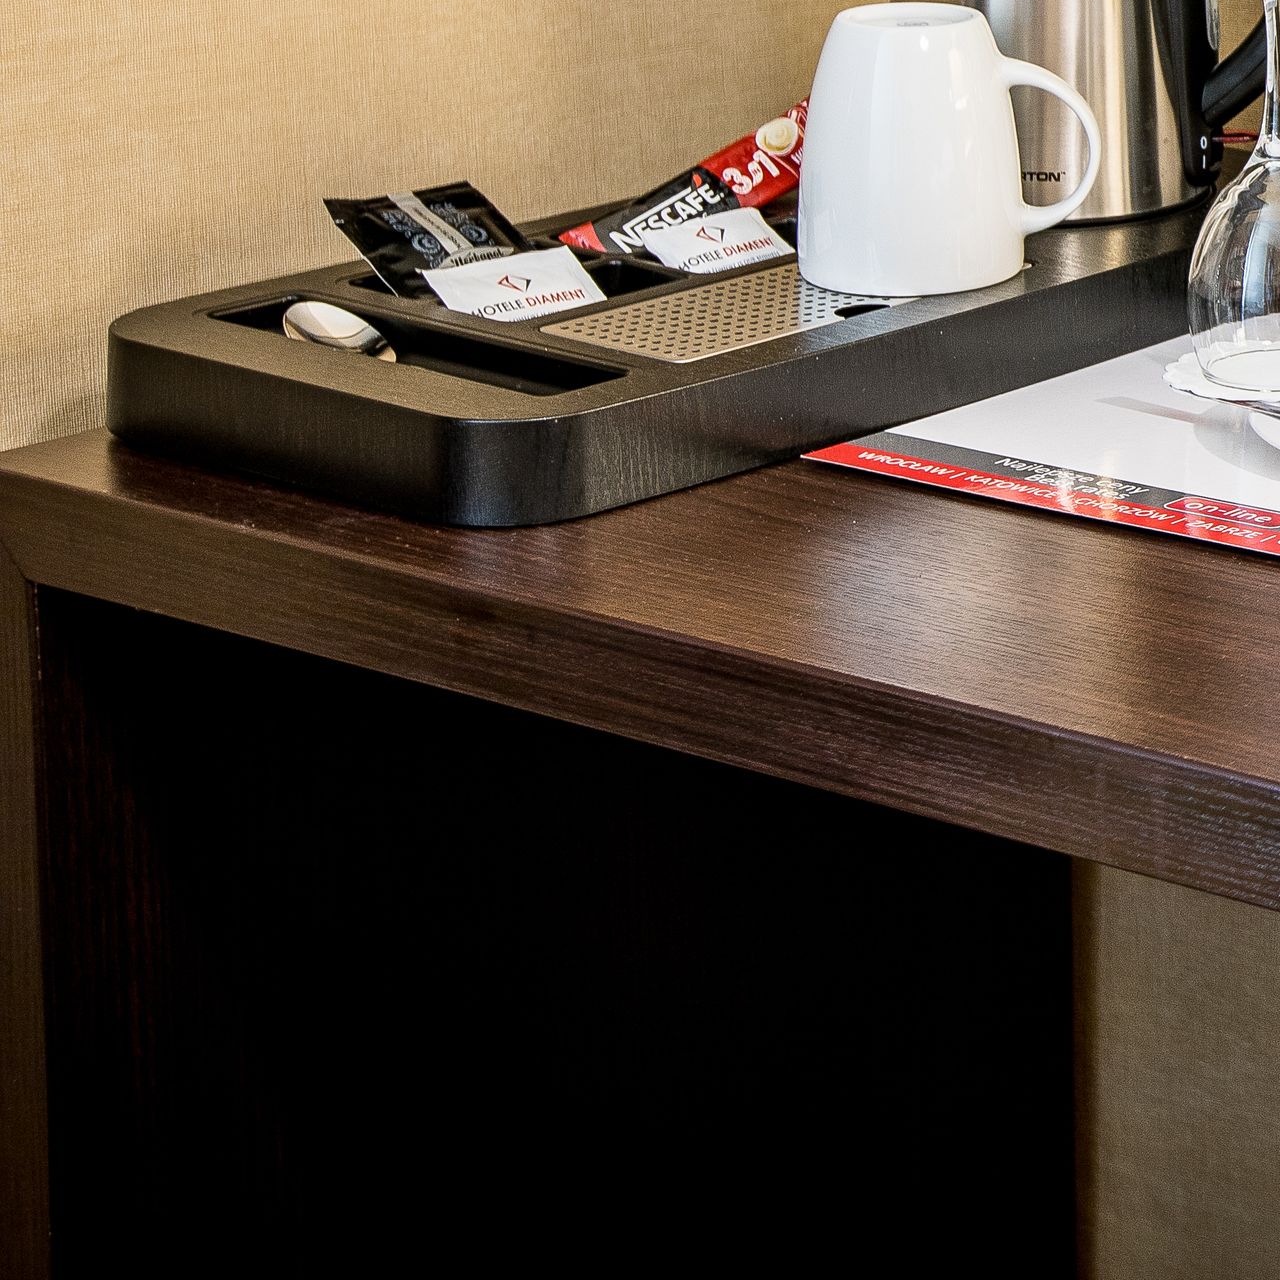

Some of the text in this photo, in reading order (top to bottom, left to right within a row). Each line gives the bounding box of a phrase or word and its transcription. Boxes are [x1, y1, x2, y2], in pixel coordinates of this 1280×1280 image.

[609, 172, 722, 254] NESCAFÉ
[678, 250, 723, 270] HOTELE
[723, 236, 774, 257] DIAMENT
[525, 289, 586, 308] DIAMENT
[858, 451, 953, 476] WROCŁAW
[964, 474, 1058, 499] KATOWICE
[1074, 497, 1175, 522] CHORZÓW
[1186, 519, 1263, 539] ZABRZE
[1079, 483, 1131, 501] rates
[1096, 477, 1150, 495] ceny
[1184, 502, 1273, 523] on-line
